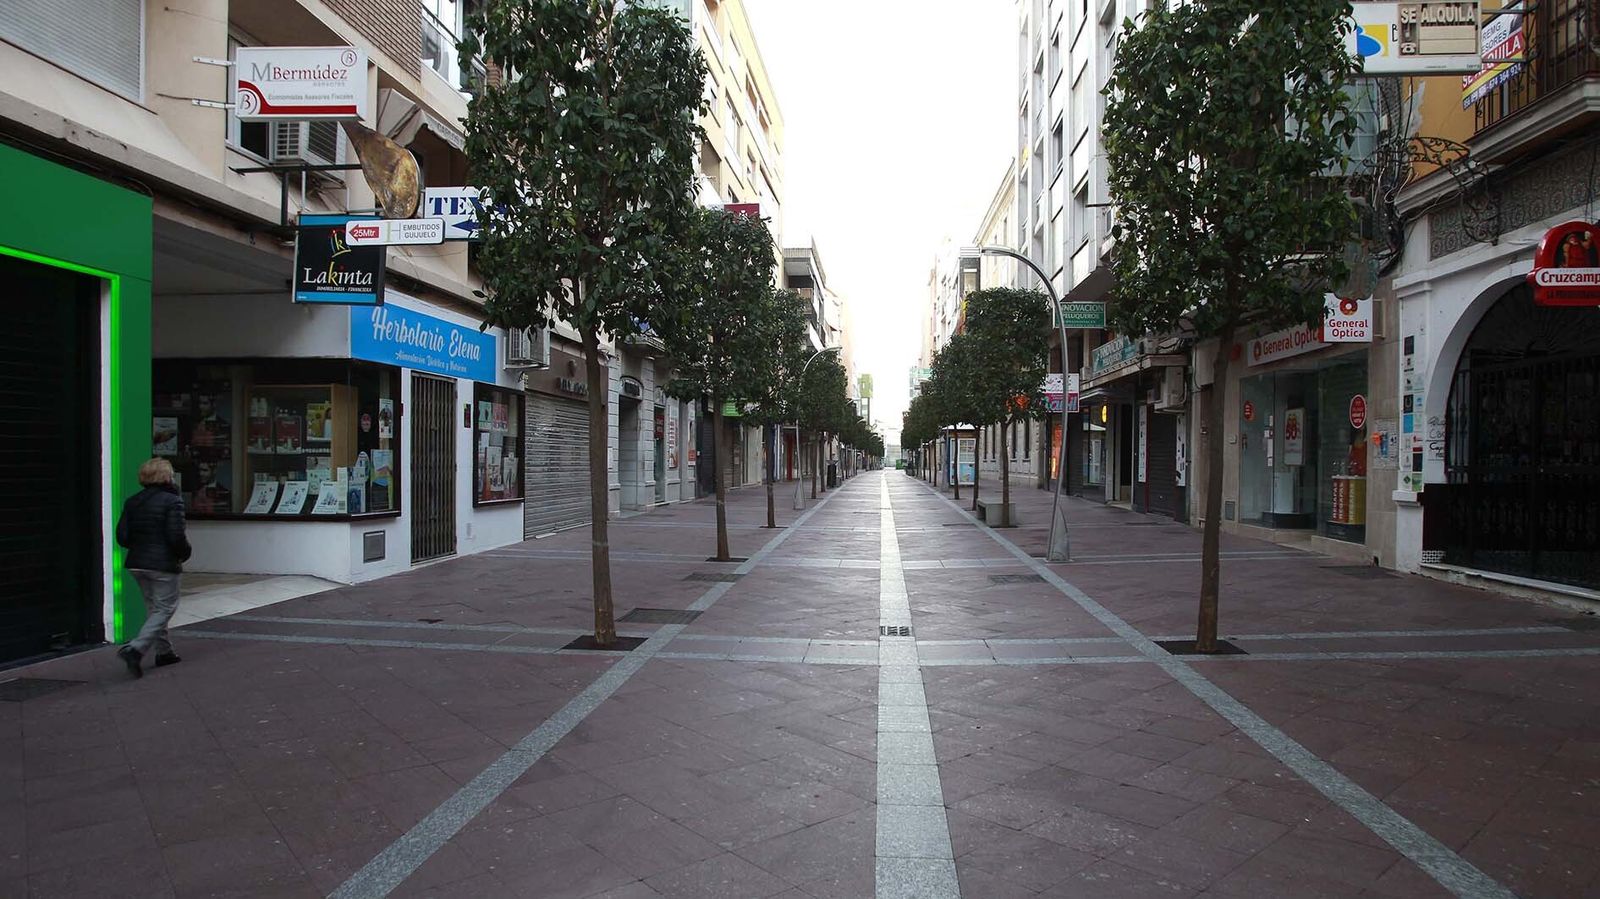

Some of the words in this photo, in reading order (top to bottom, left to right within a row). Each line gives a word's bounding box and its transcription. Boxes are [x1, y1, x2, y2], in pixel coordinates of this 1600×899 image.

[1401, 8, 1416, 24] SE
[1421, 6, 1475, 23] ALQUILA
[353, 229, 376, 238] 25Mtr
[404, 231, 437, 239] GUIJUELO
[303, 261, 372, 286] Lakinta
[1541, 271, 1600, 284] Cruzcamp
[1328, 318, 1368, 328] General
[371, 306, 445, 352] Herbolario
[448, 328, 480, 361] Elena
[1331, 328, 1365, 339] Optica
[1263, 331, 1293, 355] General
[1294, 328, 1317, 350] Optic
